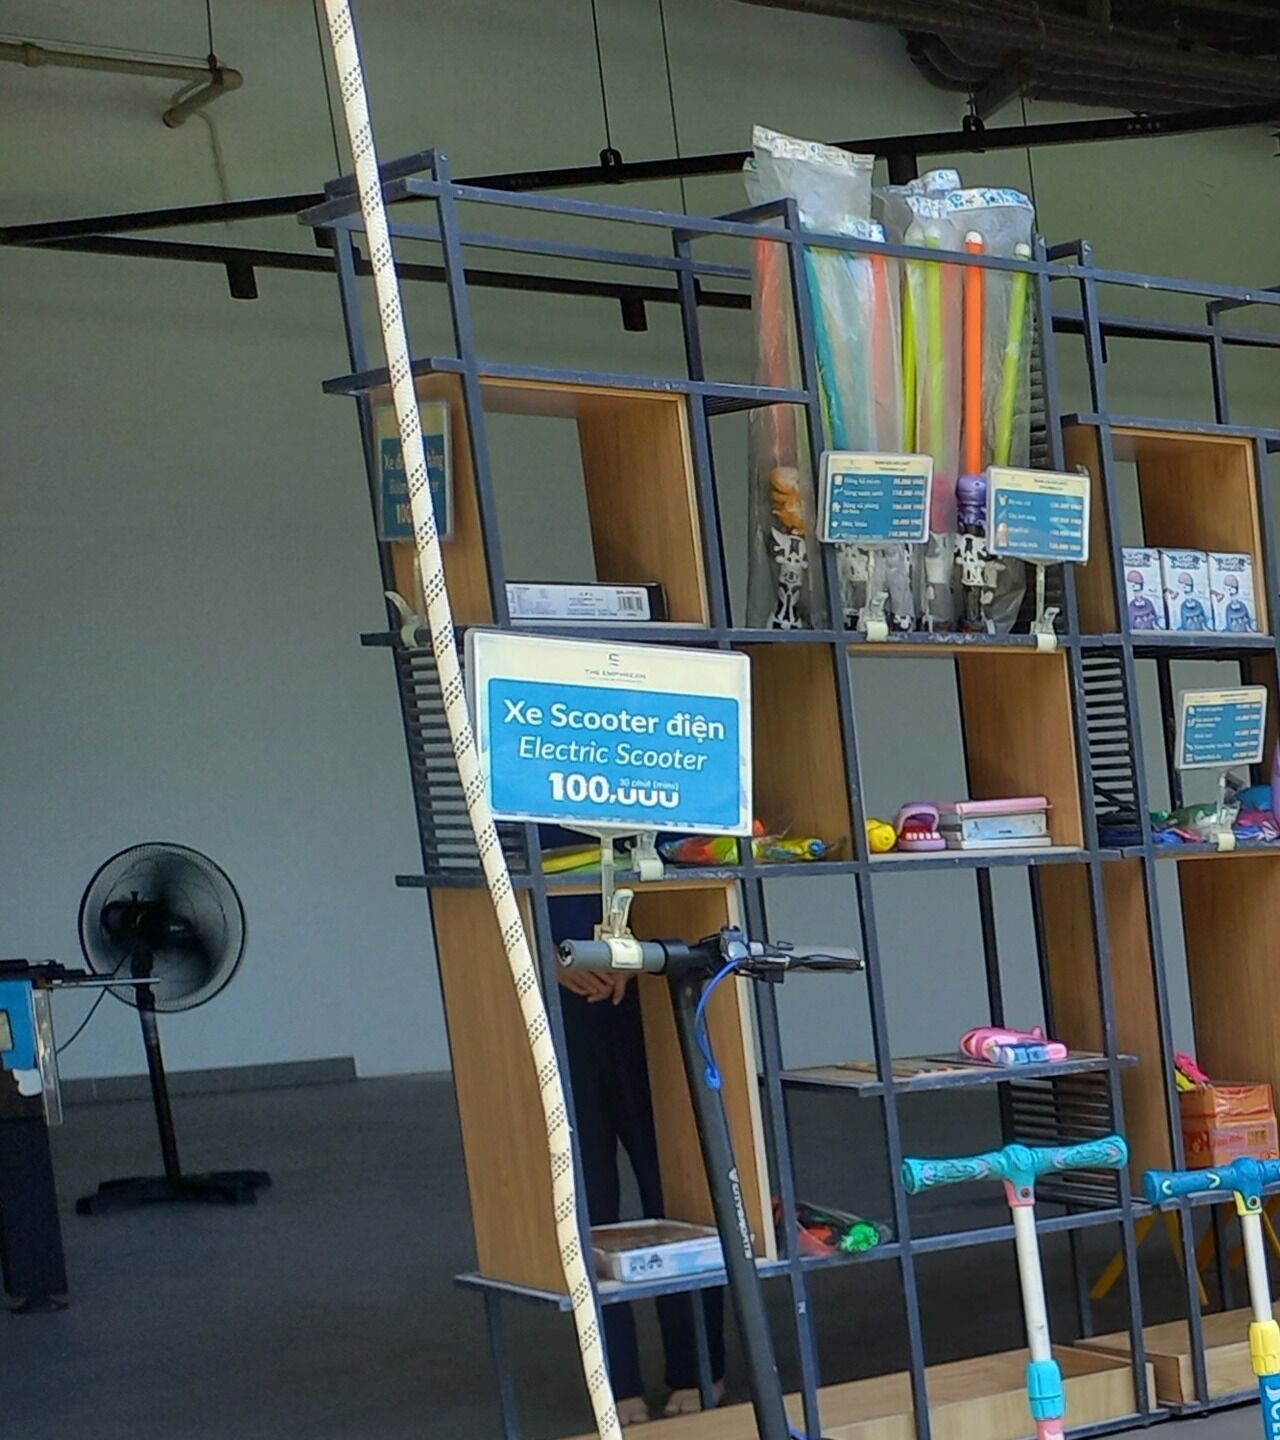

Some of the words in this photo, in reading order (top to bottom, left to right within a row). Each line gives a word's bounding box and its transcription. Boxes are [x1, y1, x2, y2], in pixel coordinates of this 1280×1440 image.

[503, 699, 543, 726] Xe
[550, 703, 659, 734] Scooter
[666, 712, 725, 743] điện
[518, 735, 609, 764] Electric
[614, 743, 708, 771] Scooter
